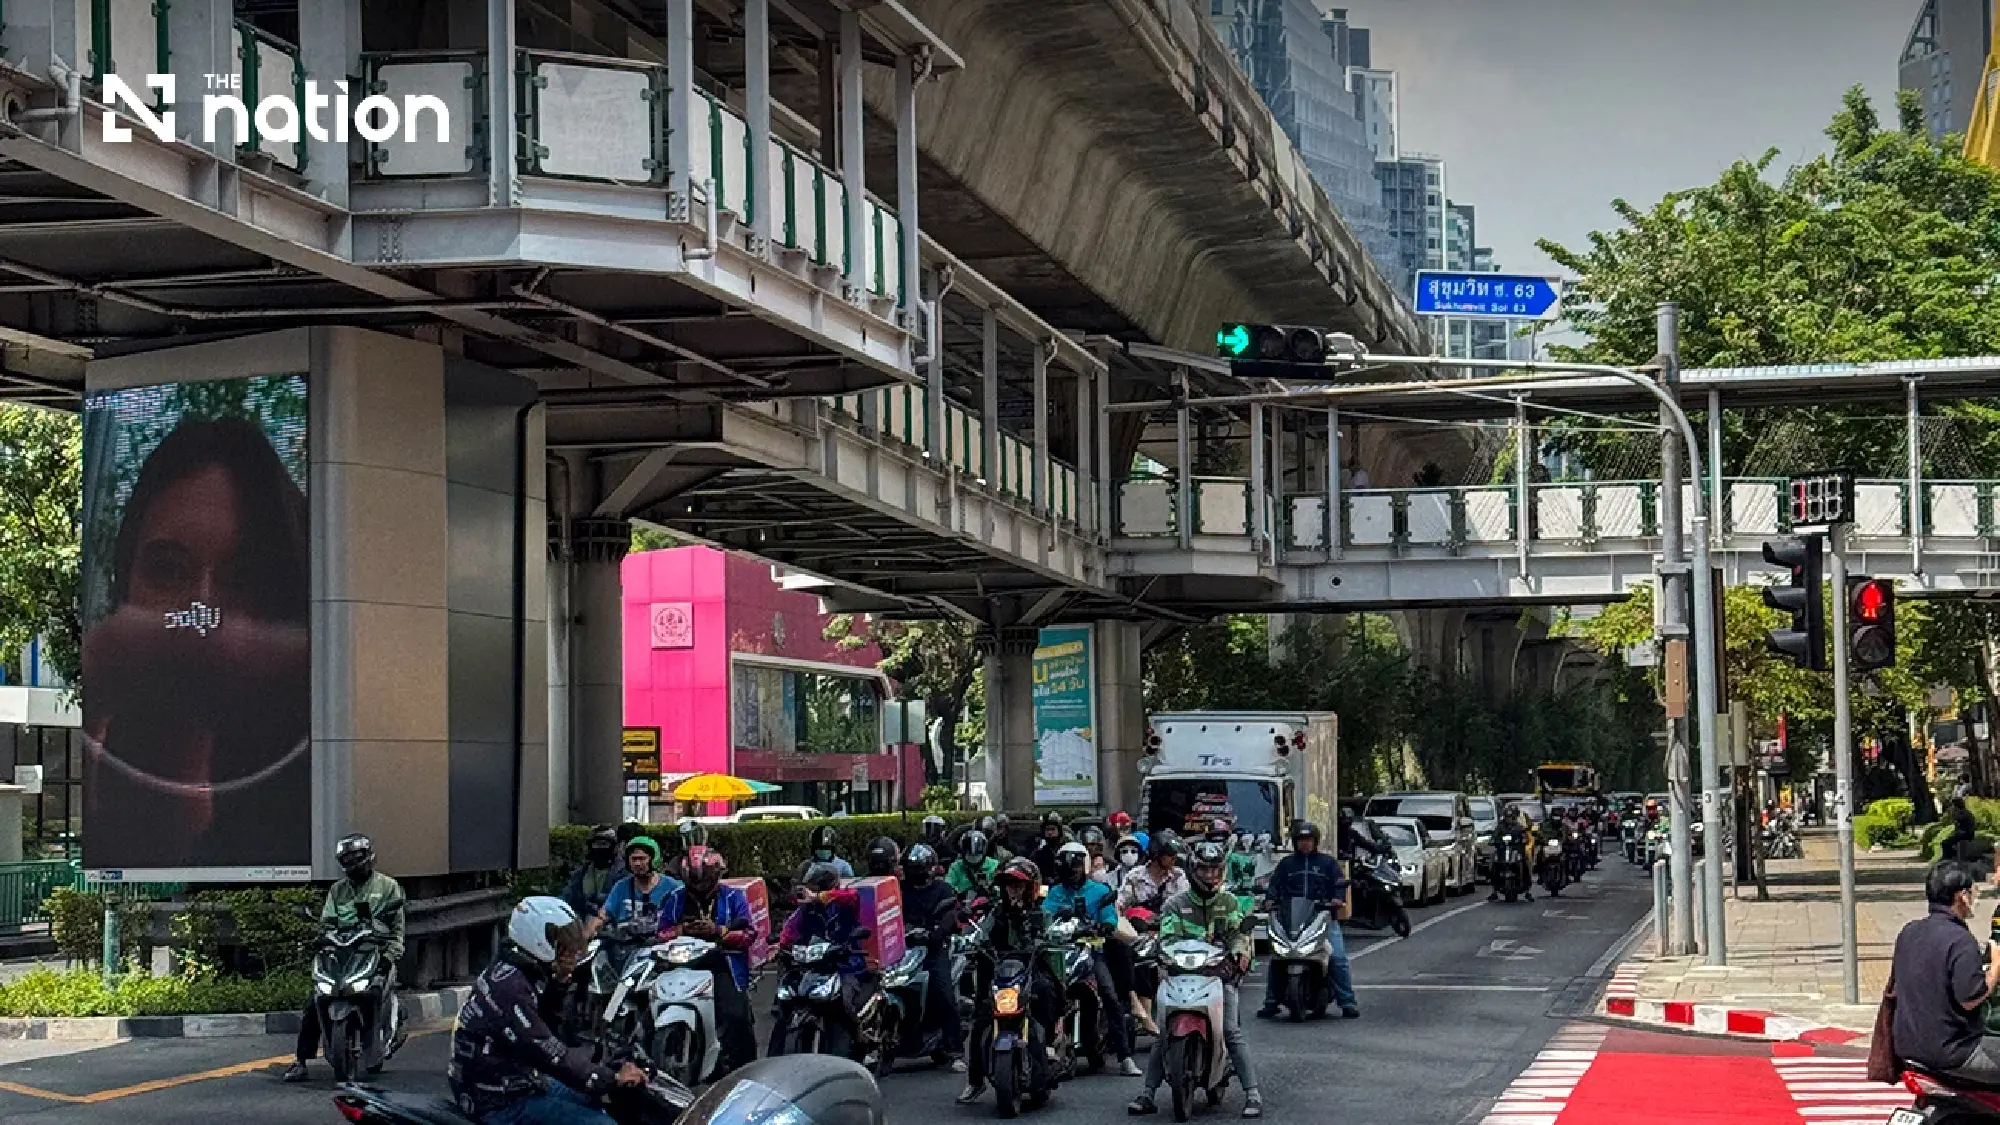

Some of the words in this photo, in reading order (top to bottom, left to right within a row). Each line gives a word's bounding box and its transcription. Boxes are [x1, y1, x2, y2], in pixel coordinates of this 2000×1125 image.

[1428, 278, 1489, 300] สุขุมวิท
[1514, 284, 1535, 299] 63
[1491, 303, 1508, 312] Soi
[1513, 303, 1526, 313] 63
